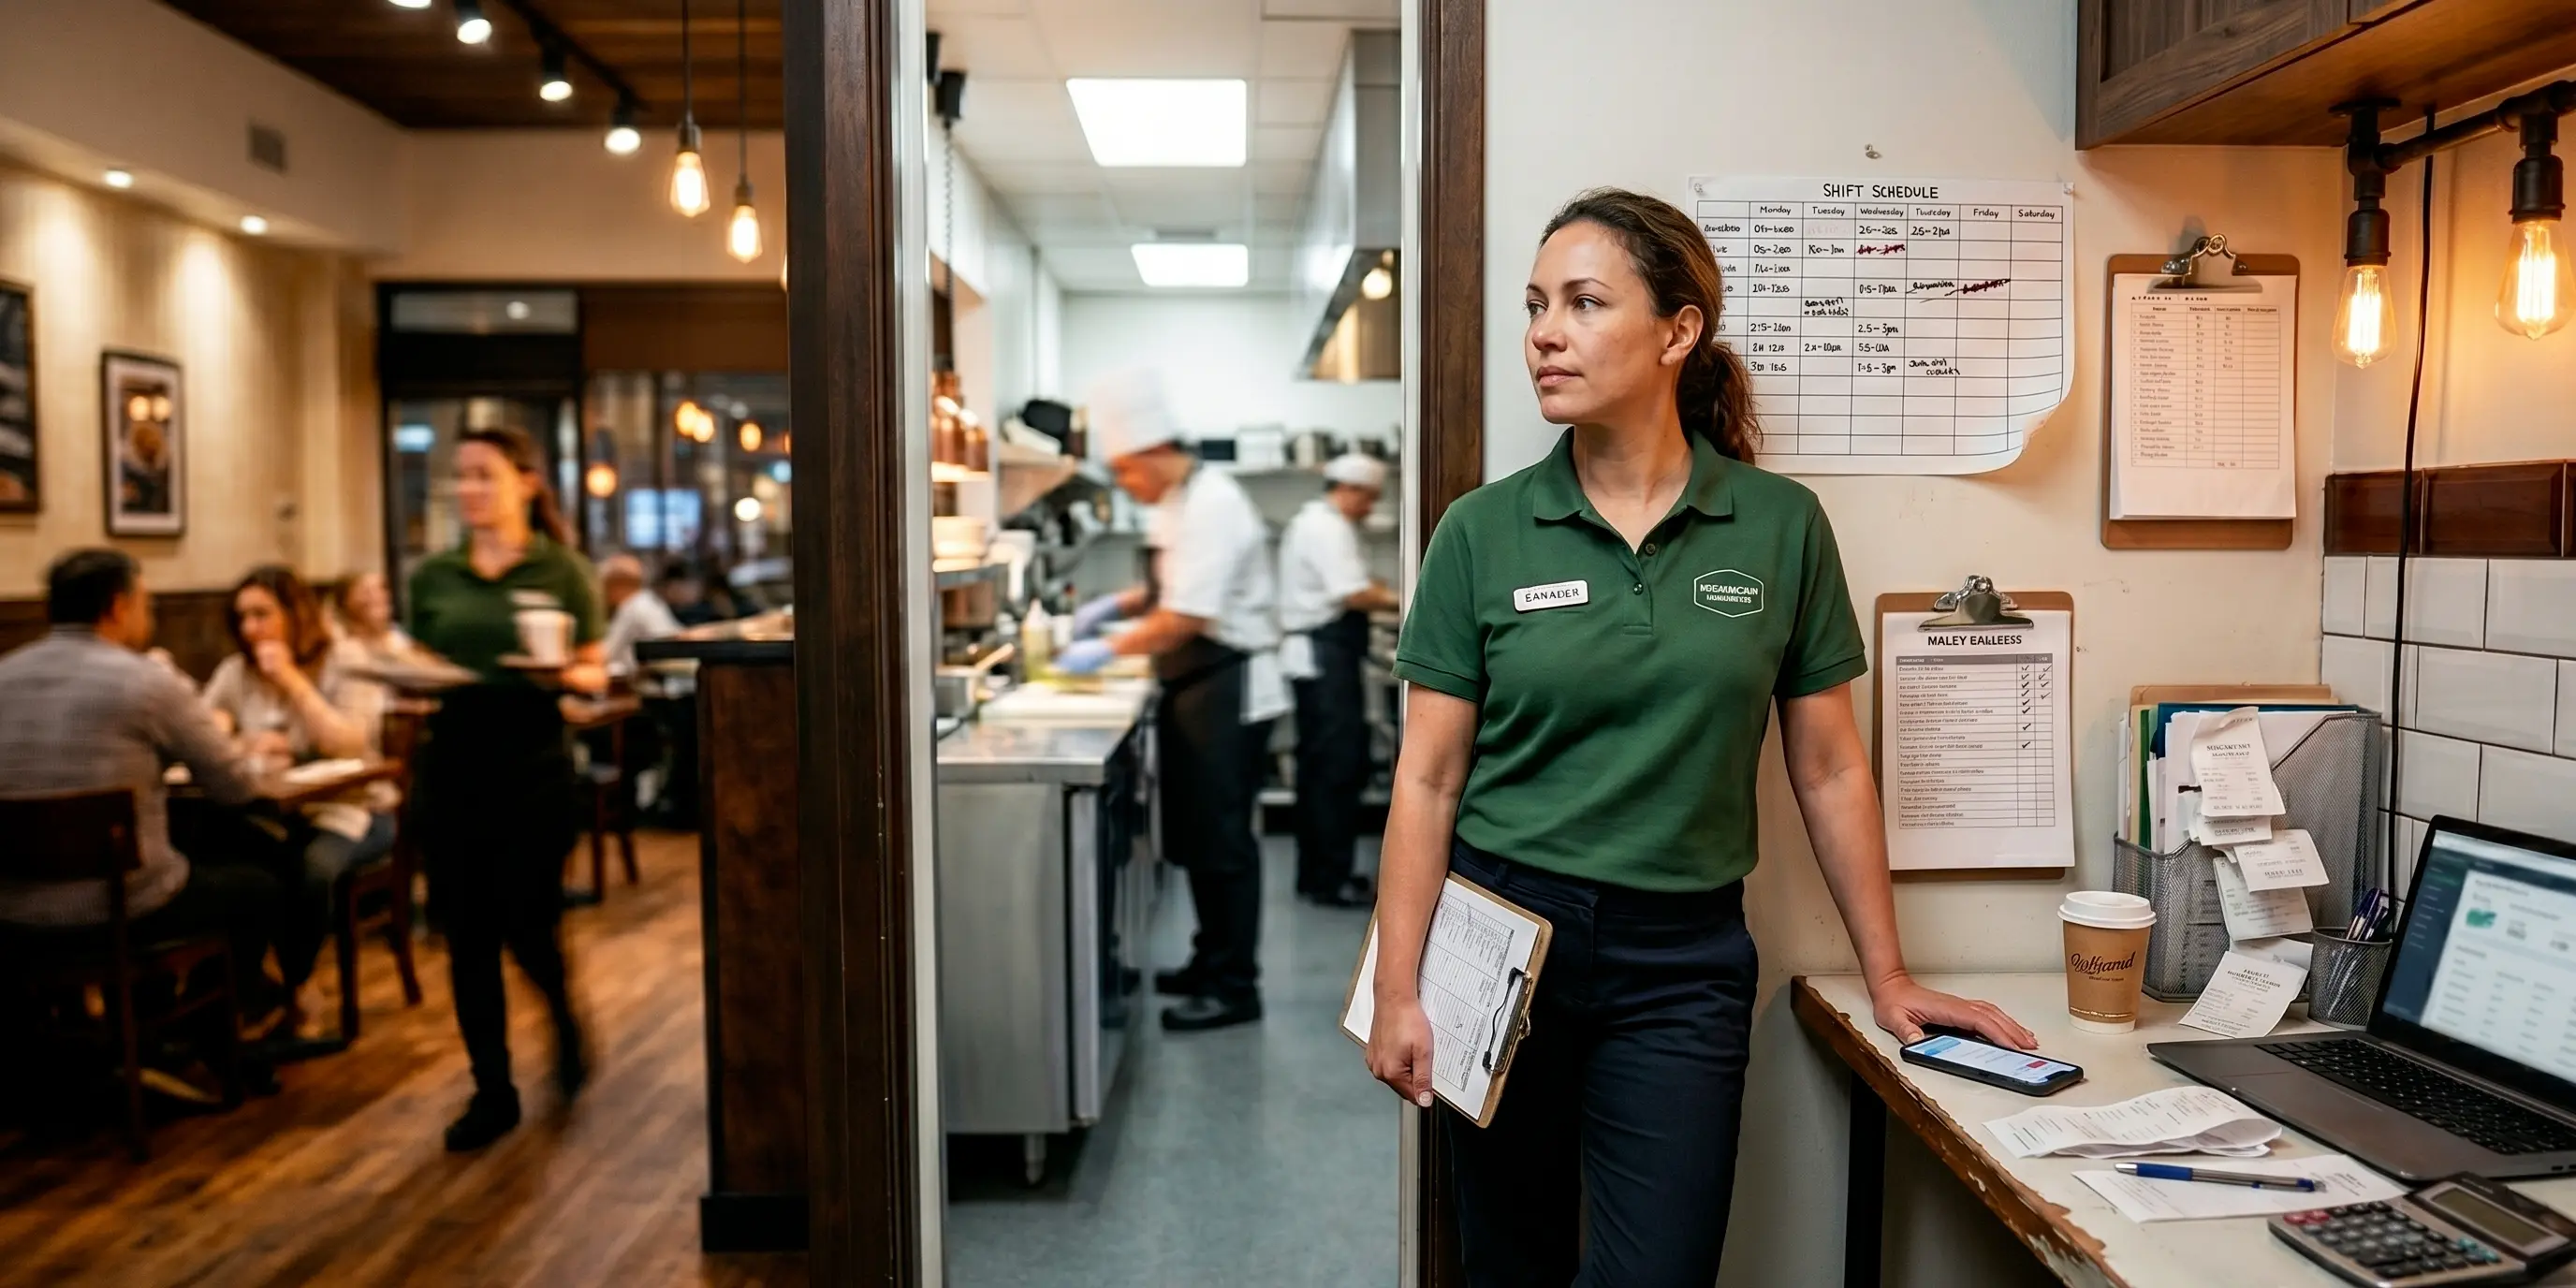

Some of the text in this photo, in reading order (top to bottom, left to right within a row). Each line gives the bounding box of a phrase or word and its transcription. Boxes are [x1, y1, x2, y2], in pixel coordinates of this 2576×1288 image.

[1823, 183, 1939, 198] SHIFT SCHEDULE
[1760, 206, 1792, 215] Monday
[1973, 209, 1999, 219] Friday
[2018, 210, 2055, 219] Saturday
[1525, 588, 1580, 603] EANADER
[1927, 636, 1967, 646] MALEY
